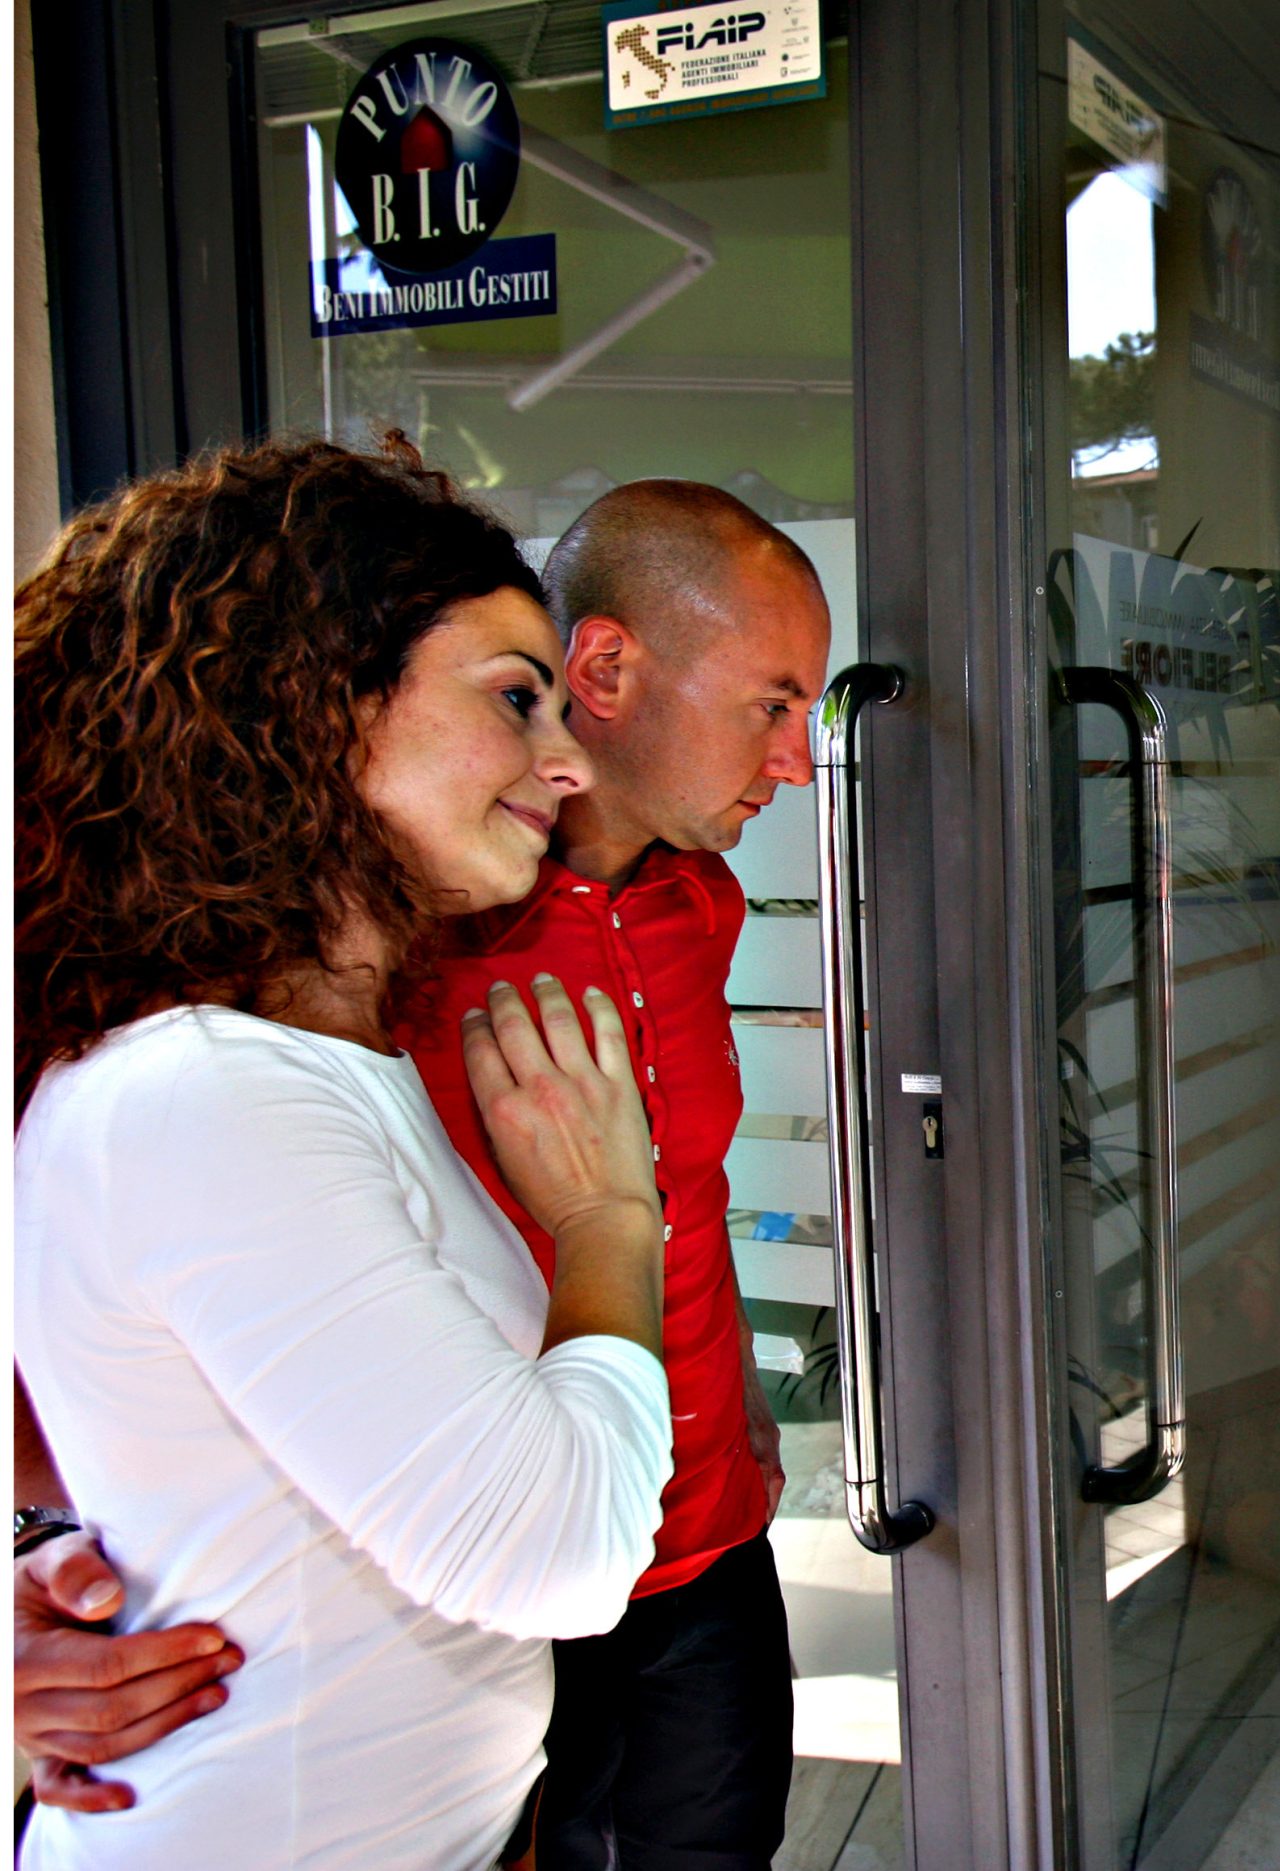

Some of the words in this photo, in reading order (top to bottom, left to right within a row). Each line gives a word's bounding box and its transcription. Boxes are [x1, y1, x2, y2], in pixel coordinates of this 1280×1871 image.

[350, 50, 499, 143] PUNTO
[317, 284, 363, 323] BENI
[369, 274, 464, 319] IMMOBILI
[469, 266, 551, 307] GESTITI
